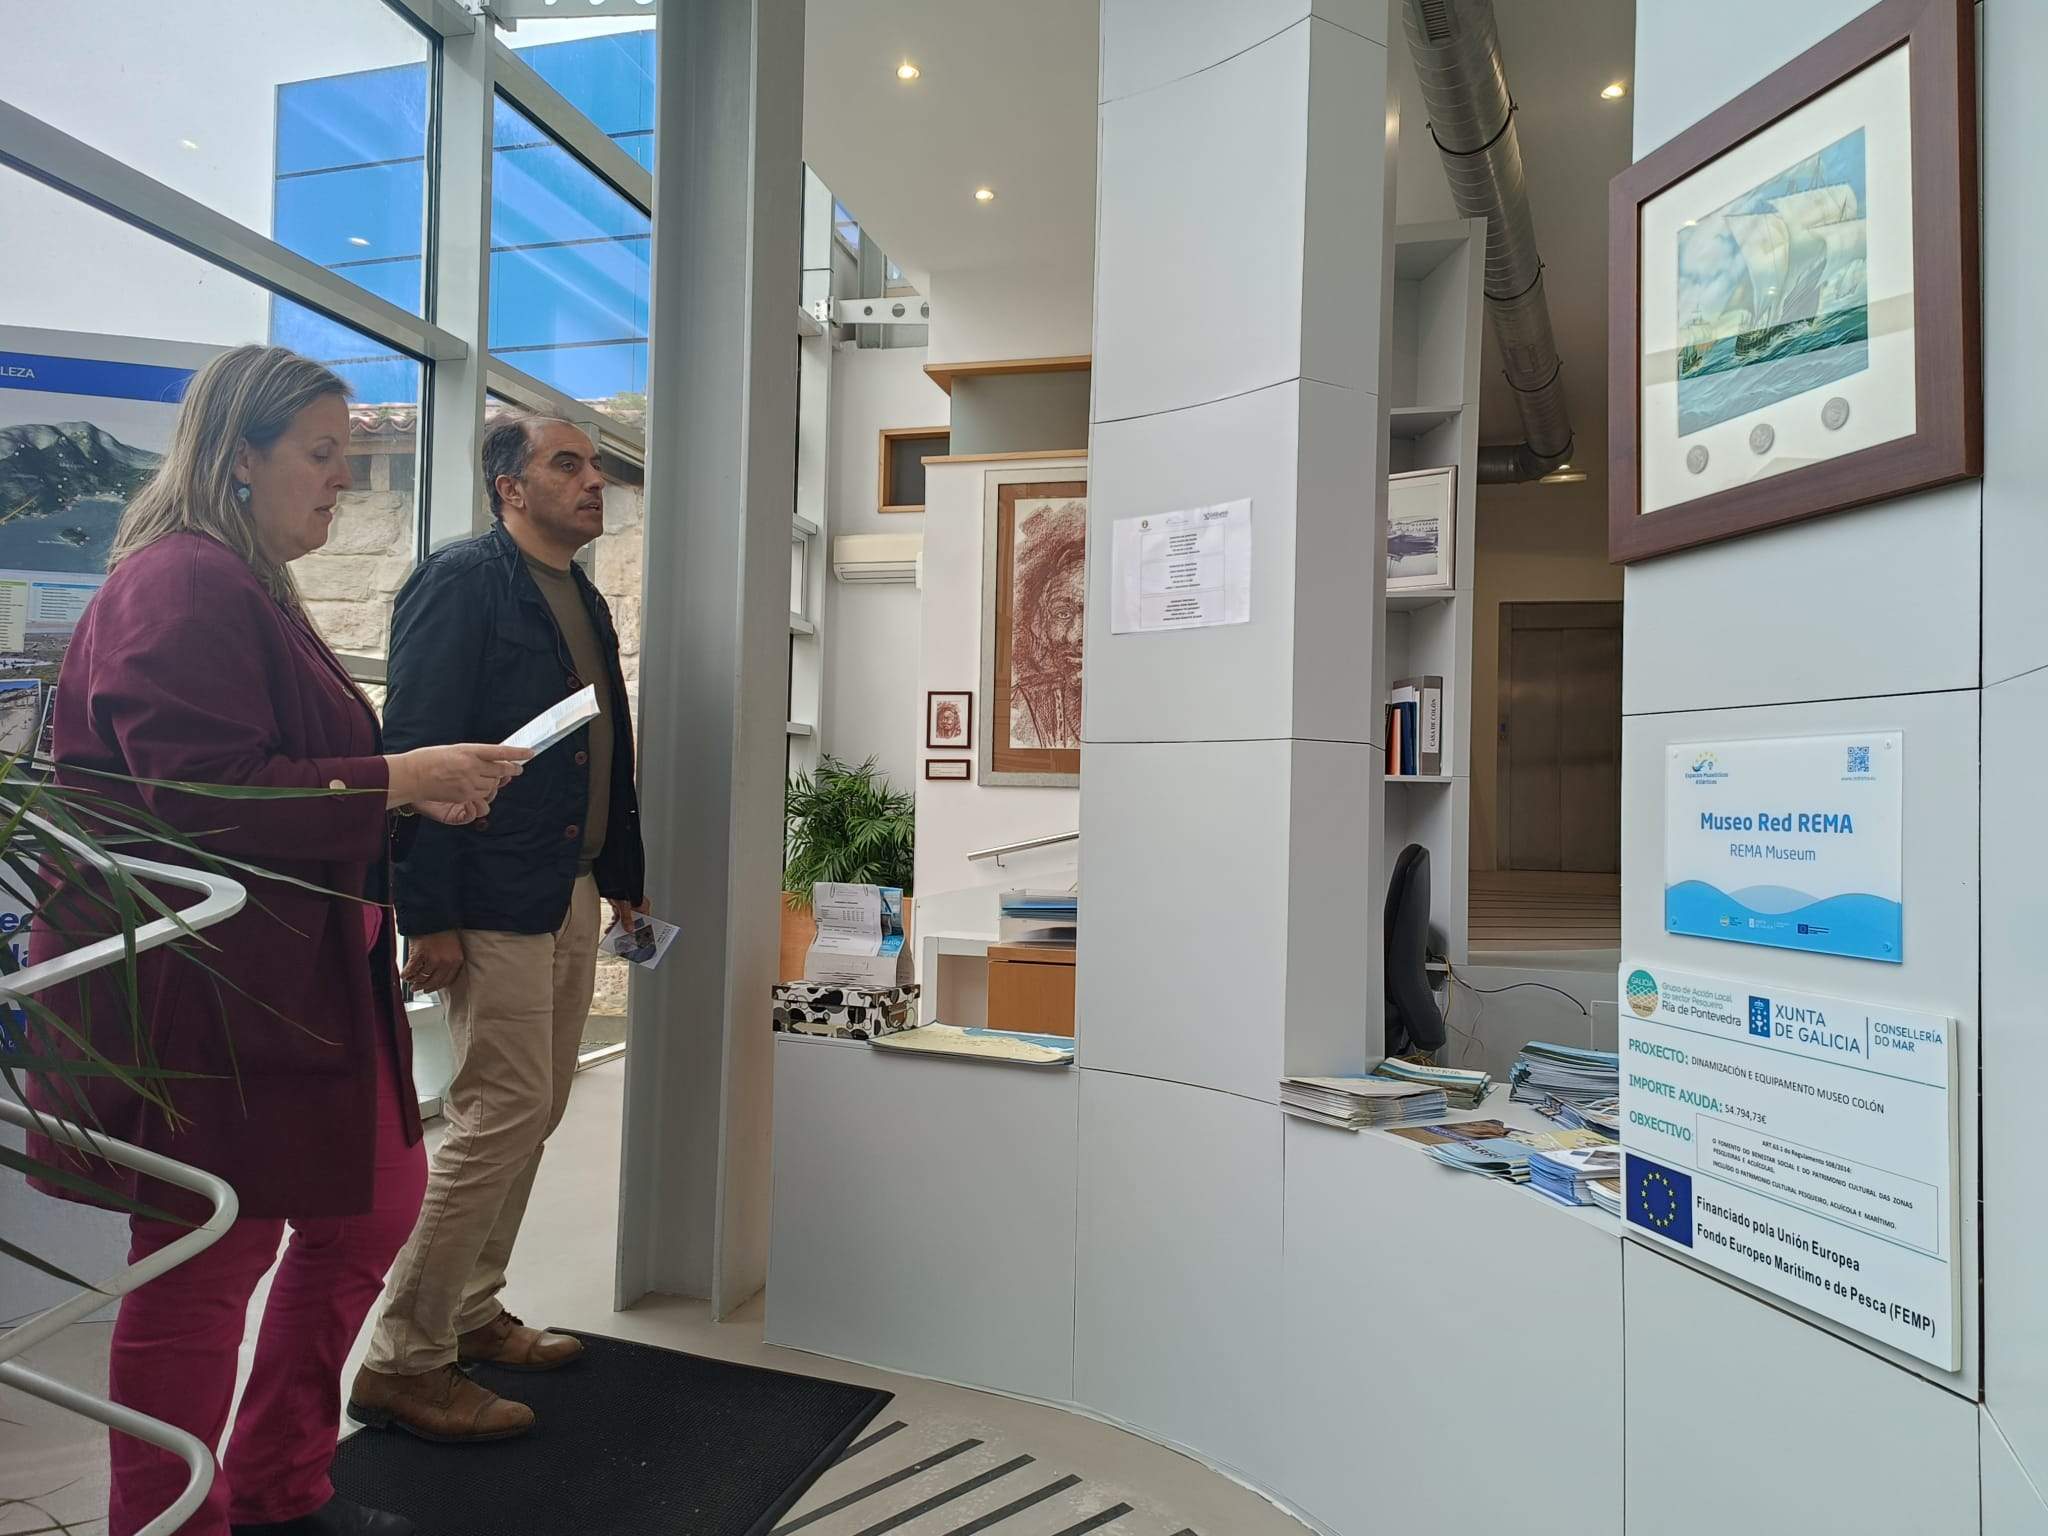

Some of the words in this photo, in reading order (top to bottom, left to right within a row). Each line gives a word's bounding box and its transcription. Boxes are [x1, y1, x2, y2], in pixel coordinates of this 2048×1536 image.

[1700, 812, 1753, 832] Museo
[1757, 812, 1792, 833] Red
[1798, 813, 1853, 834] REMA
[1729, 843, 1763, 859] REMA
[1765, 845, 1816, 861] Museum
[1661, 982, 1681, 993] Grupo
[1682, 986, 1691, 995] de
[1692, 987, 1714, 999] Acción
[1661, 1000, 1676, 1013] Ría
[1677, 1004, 1689, 1015] de
[1690, 1005, 1742, 1027] Pontevedra
[1775, 1004, 1826, 1027] XUNTA
[1775, 1022, 1793, 1039] DE
[1798, 1028, 1861, 1054] GALICIA
[1874, 1022, 1943, 1044] CONSELLERÍA
[1874, 1035, 1890, 1047] DO
[1892, 1037, 1916, 1052] MAR
[1628, 1038, 1689, 1065] PROXECTO:
[1691, 1056, 1747, 1079] DINAMIZACIÓN
[1748, 1070, 1754, 1080] E
[1754, 1072, 1815, 1096] EQUIPAMENTO
[1816, 1088, 1850, 1105] MUSEO
[1851, 1097, 1885, 1114] COLÓN
[1628, 1074, 1676, 1099] IMPORTE
[1678, 1088, 1723, 1113] AXUDA:
[1777, 1159, 1795, 1170] SOCIAL
[1801, 1167, 1811, 1175] DO
[1811, 1170, 1847, 1188] PATRIMONIO
[1848, 1182, 1878, 1198] CULTURAL
[1878, 1192, 1891, 1202] DAS
[1892, 1196, 1914, 1209] ZONAS
[1696, 1194, 1751, 1228] Financiado
[1753, 1220, 1775, 1239] pola
[1777, 1226, 1809, 1252] Unión
[1812, 1240, 1861, 1272] Europea
[1696, 1223, 1727, 1248] Fondo
[1729, 1236, 1772, 1265] Europeo
[1824, 1279, 1831, 1291] e
[1833, 1281, 1847, 1297] de
[1850, 1286, 1887, 1314] Pesca
[1889, 1302, 1936, 1339] (FEMP)
